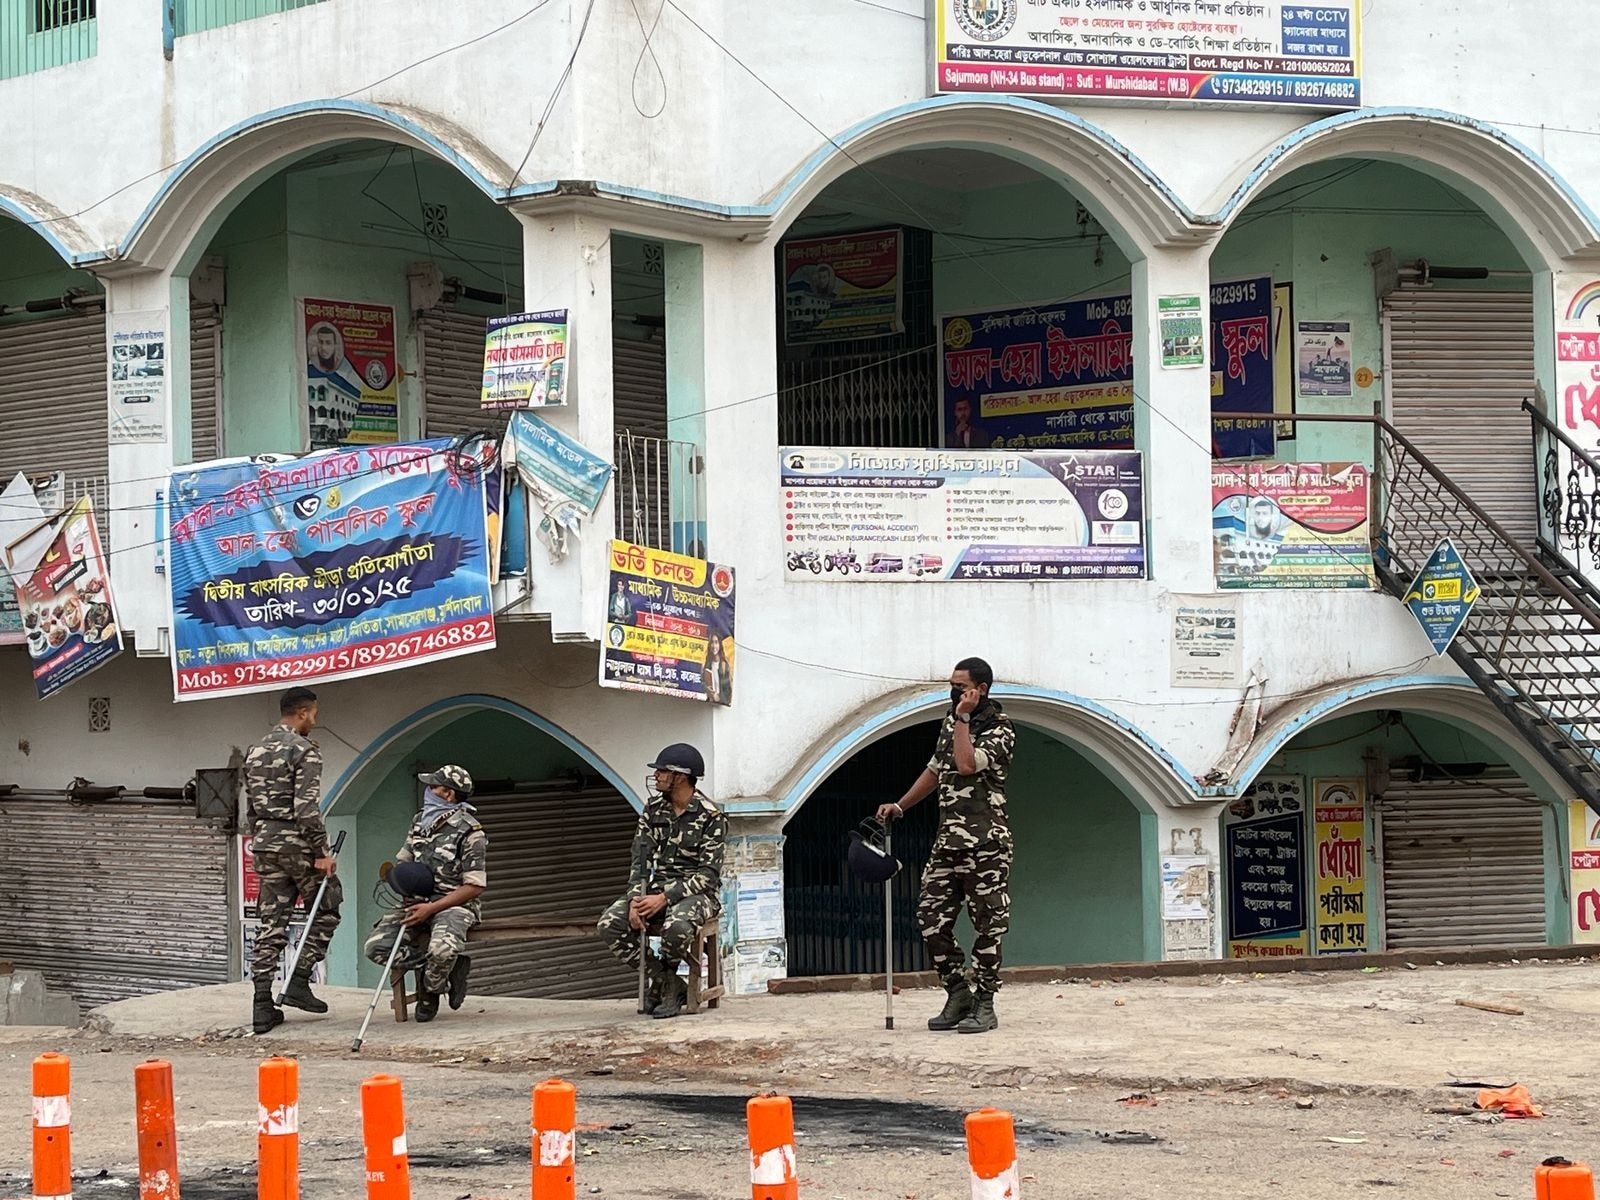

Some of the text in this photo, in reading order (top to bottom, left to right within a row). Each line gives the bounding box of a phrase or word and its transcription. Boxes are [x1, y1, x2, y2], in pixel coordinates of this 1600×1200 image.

[1315, 10, 1347, 23] CCTV
[1193, 57, 1218, 69] Govt.
[1220, 59, 1244, 71] Regd
[1247, 60, 1263, 70] No-
[1281, 61, 1351, 74] 120100065/2024
[945, 68, 988, 86] Sajurmore
[990, 70, 1019, 87] (NH-34
[1020, 72, 1037, 86] Bus
[1039, 72, 1065, 91] stand)
[1077, 75, 1094, 89] Suti
[1105, 76, 1159, 92] Murshidabad
[1167, 79, 1190, 95] (W.B)
[1222, 81, 1283, 97] 9734829915
[1294, 83, 1356, 98] 8926746882
[1086, 302, 1112, 321] Mob-
[1221, 314, 1270, 386] স্কুল
[945, 341, 1043, 392] আল-হেরা
[1074, 465, 1116, 476] STAR
[306, 506, 390, 545] পাবলিক
[613, 545, 696, 584] ভর্তি চলছে
[203, 574, 245, 603] দ্বিতীয়
[313, 575, 412, 615] ৩০/০১/২৫
[180, 620, 493, 690] Mob: 9734829915/8926746882
[1318, 824, 1364, 884] ধোঁয়া
[1248, 864, 1265, 876] এবং
[1241, 881, 1269, 893] রকমের
[1319, 885, 1365, 918] পরীক্ষা
[1319, 921, 1366, 948] করা হয়
